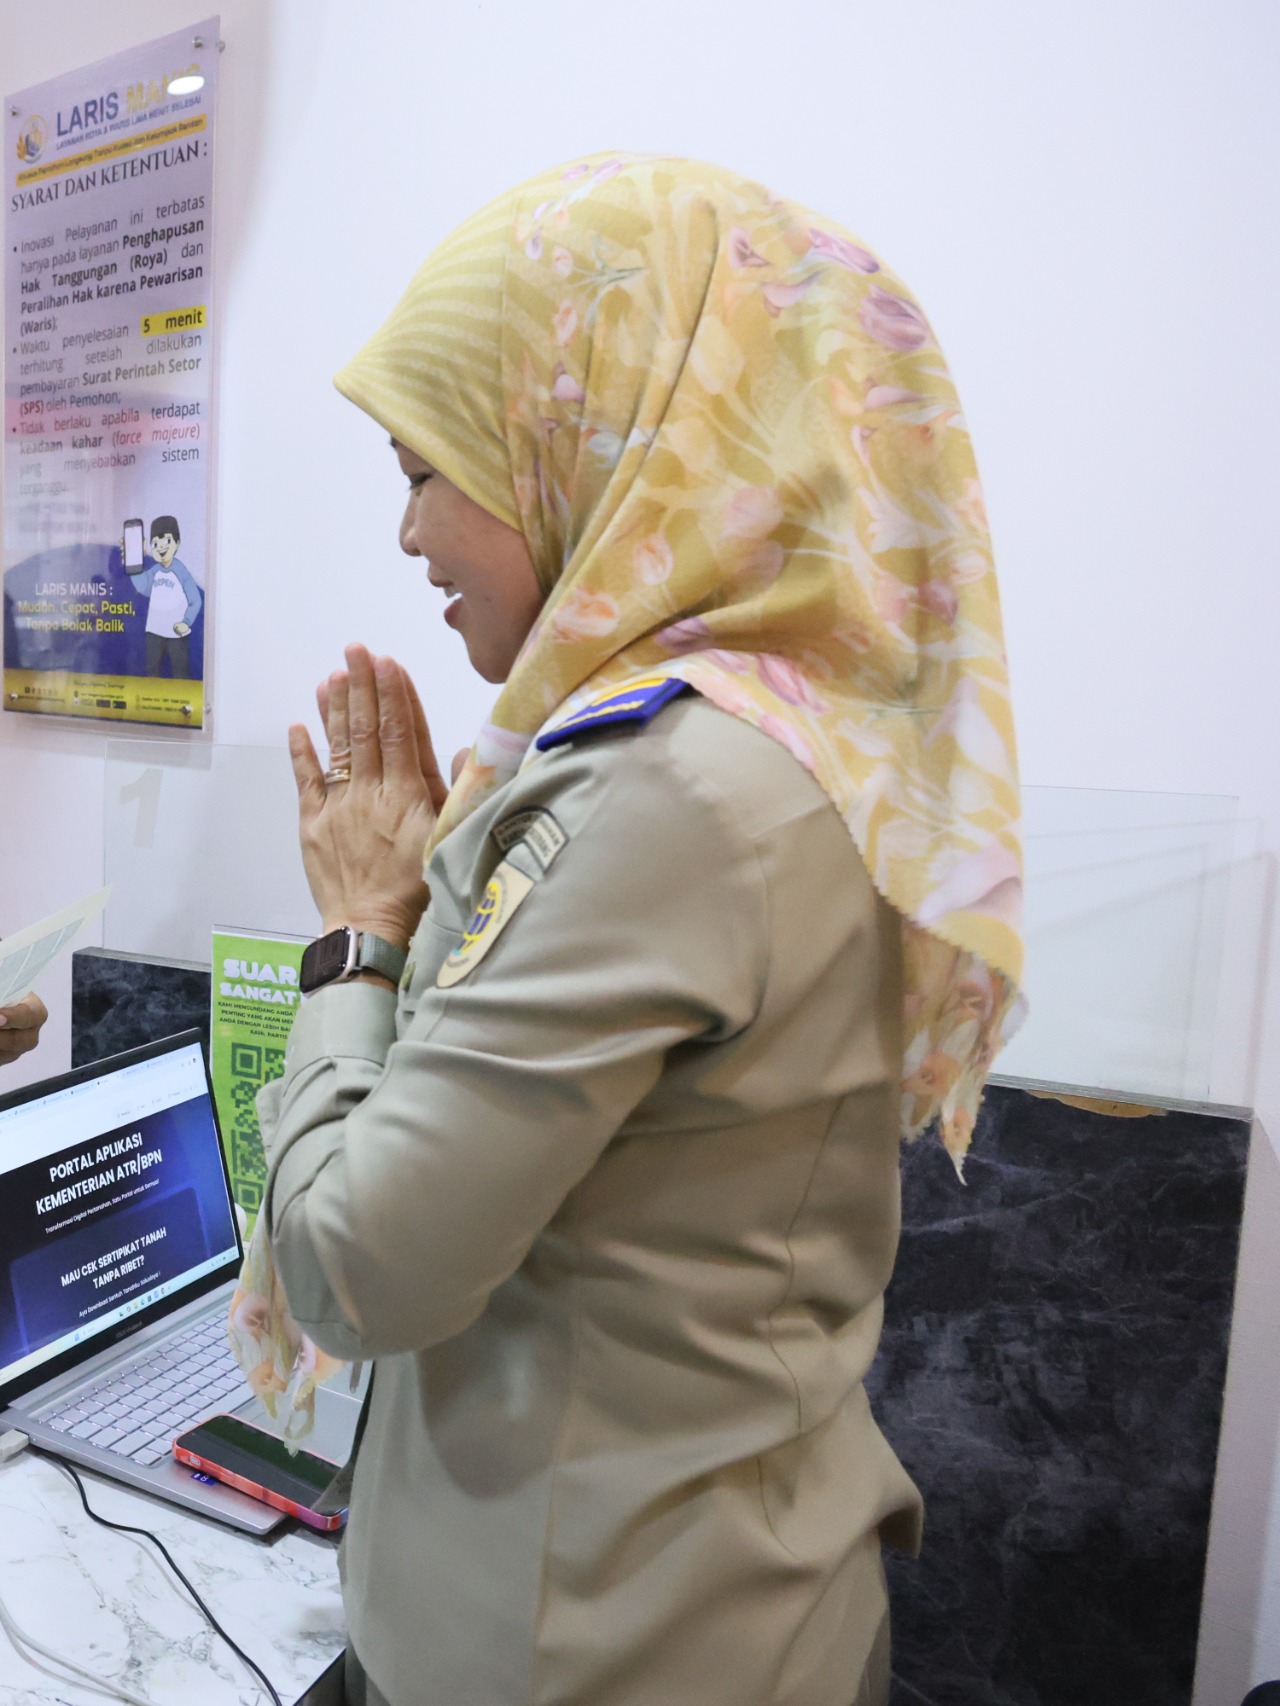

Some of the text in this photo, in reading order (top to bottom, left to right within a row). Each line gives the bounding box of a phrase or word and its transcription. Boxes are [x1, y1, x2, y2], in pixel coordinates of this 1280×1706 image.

[56, 91, 120, 137] LARIS
[11, 182, 62, 213] SYARAT
[65, 173, 97, 197] DAN
[101, 140, 200, 186] KETENTUAN
[21, 195, 205, 254] Inovasi Pelayanan ini terbatas
[20, 218, 204, 275] hanya pada layanan Penghapusan
[21, 241, 204, 295] Hak Tanggungan (Roya) dan
[21, 264, 203, 316] Peralihan Hak karena Pewarisan
[20, 309, 202, 355] Waktu penyelesaian 5 menit
[20, 334, 202, 376] terhitung setelah dilakukan
[20, 356, 202, 397] pembayaran Surat Perintah Setor
[20, 390, 122, 418] (SPS) oleh Pemohon;
[20, 402, 201, 435] Tidak berlaku apabila terdapat
[20, 423, 200, 455] keadaan kahar (force majeure)
[64, 452, 136, 473] menyebabkan
[162, 447, 200, 463] sistem
[35, 582, 67, 596] LARIS
[69, 582, 107, 596] MANIS
[25, 617, 125, 632] Tanpa Bolak Balik
[61, 601, 98, 616] Cepat,
[101, 600, 136, 616] Pasti,
[119, 767, 164, 849] 1
[223, 958, 300, 986] SUAR
[220, 982, 297, 1006] SANGAT
[233, 1003, 275, 1014] MENGUNDANG
[276, 1009, 293, 1017] ANDA
[221, 1009, 246, 1018] PENTING
[237, 1019, 261, 1028] DENGAN
[49, 1131, 143, 1183] PORTAL APLIKASI
[35, 1148, 163, 1215] KEMENTERIAN ATR/BPN
[45, 1215, 74, 1234] Transformasi
[73, 1210, 88, 1222] Digital
[60, 1226, 168, 1287] MAU CEK SERTIPIKAT TANAH
[92, 1254, 145, 1290] TANPA RIBET?
[78, 1309, 87, 1318] Ayo
[87, 1298, 108, 1314] Download
